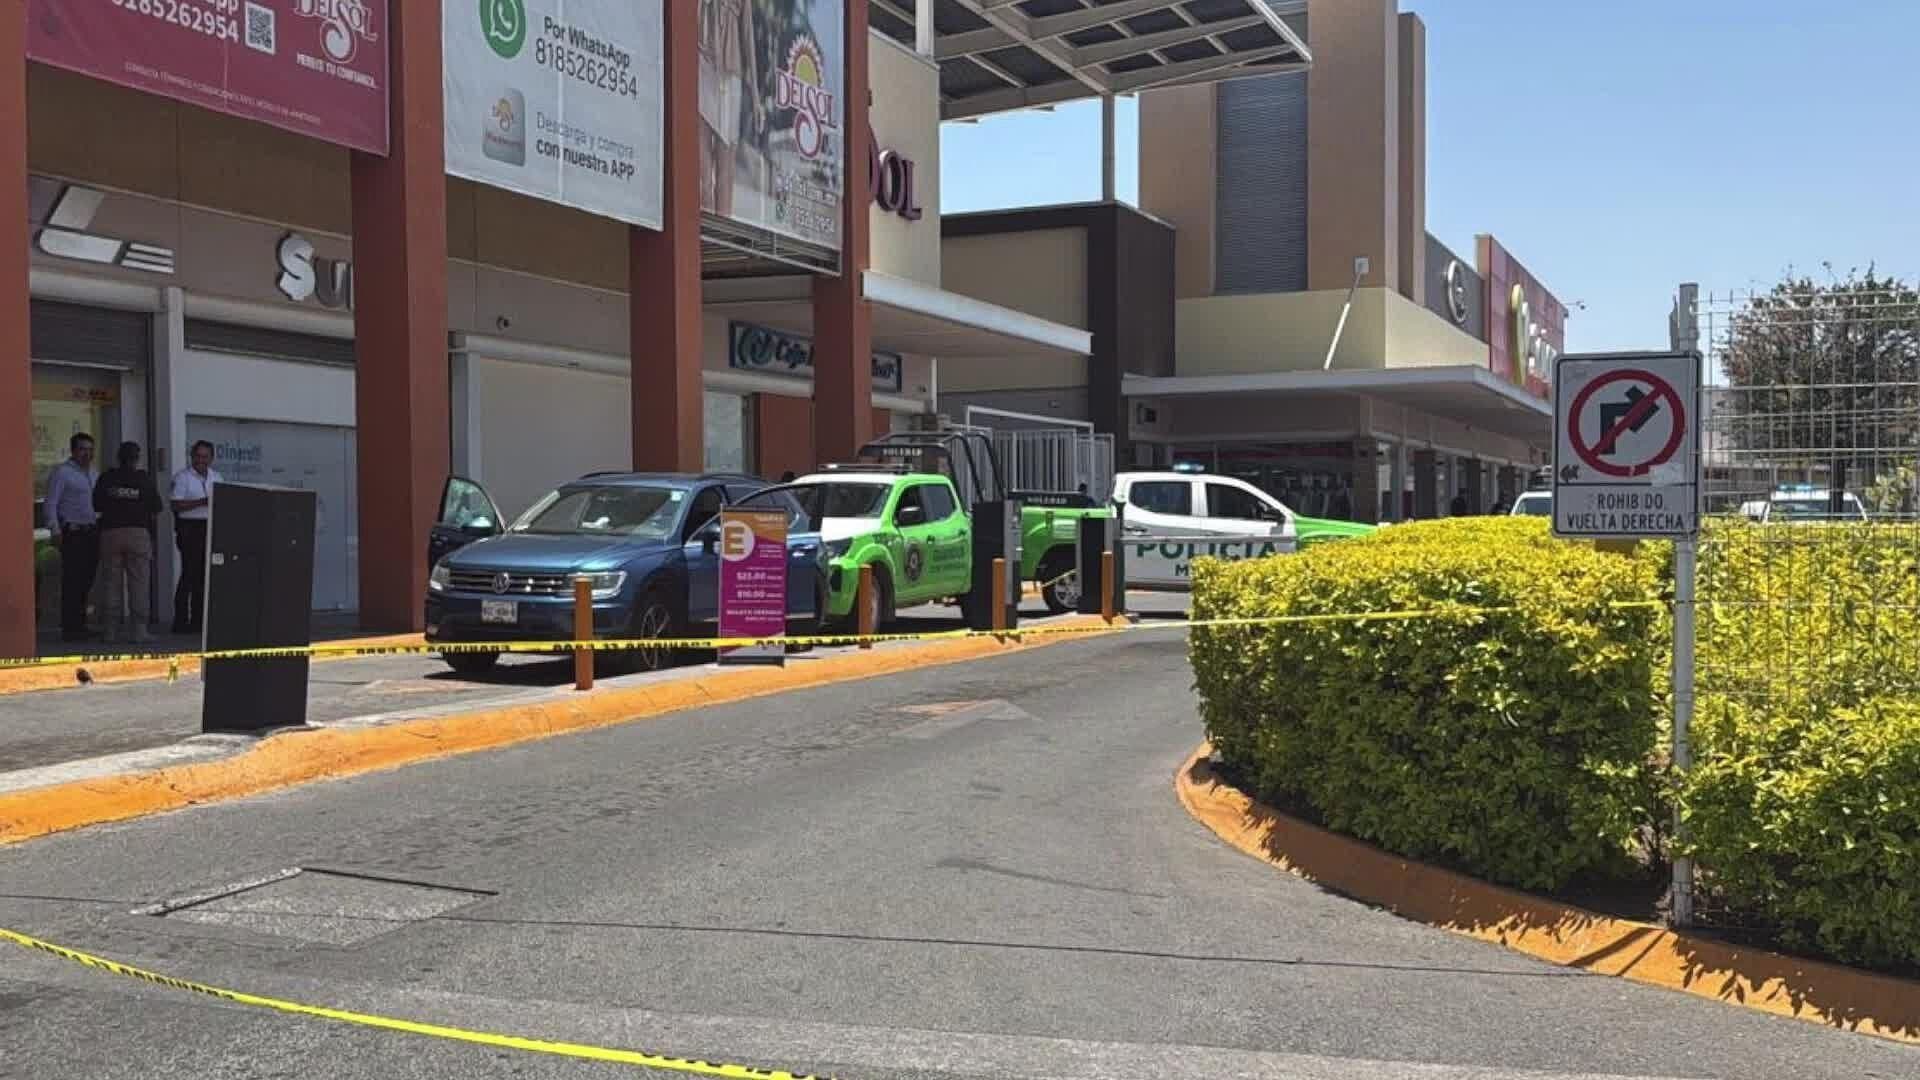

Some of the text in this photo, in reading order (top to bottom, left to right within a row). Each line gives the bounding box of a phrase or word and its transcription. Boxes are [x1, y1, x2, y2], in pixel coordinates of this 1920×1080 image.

[112, 0, 239, 43] 85262954
[544, 15, 630, 69] Por WhatsApp
[536, 36, 638, 99] 8185262954
[536, 111, 586, 147] Descarga
[588, 134, 595, 150] y
[598, 135, 634, 159] compra
[536, 138, 560, 160] con
[563, 143, 609, 177] nuestra
[611, 159, 635, 182] APP
[868, 138, 922, 221] OL
[1567, 512, 1685, 530] VUELTA DERECHA
[1594, 494, 1664, 510] ROHIBDO
